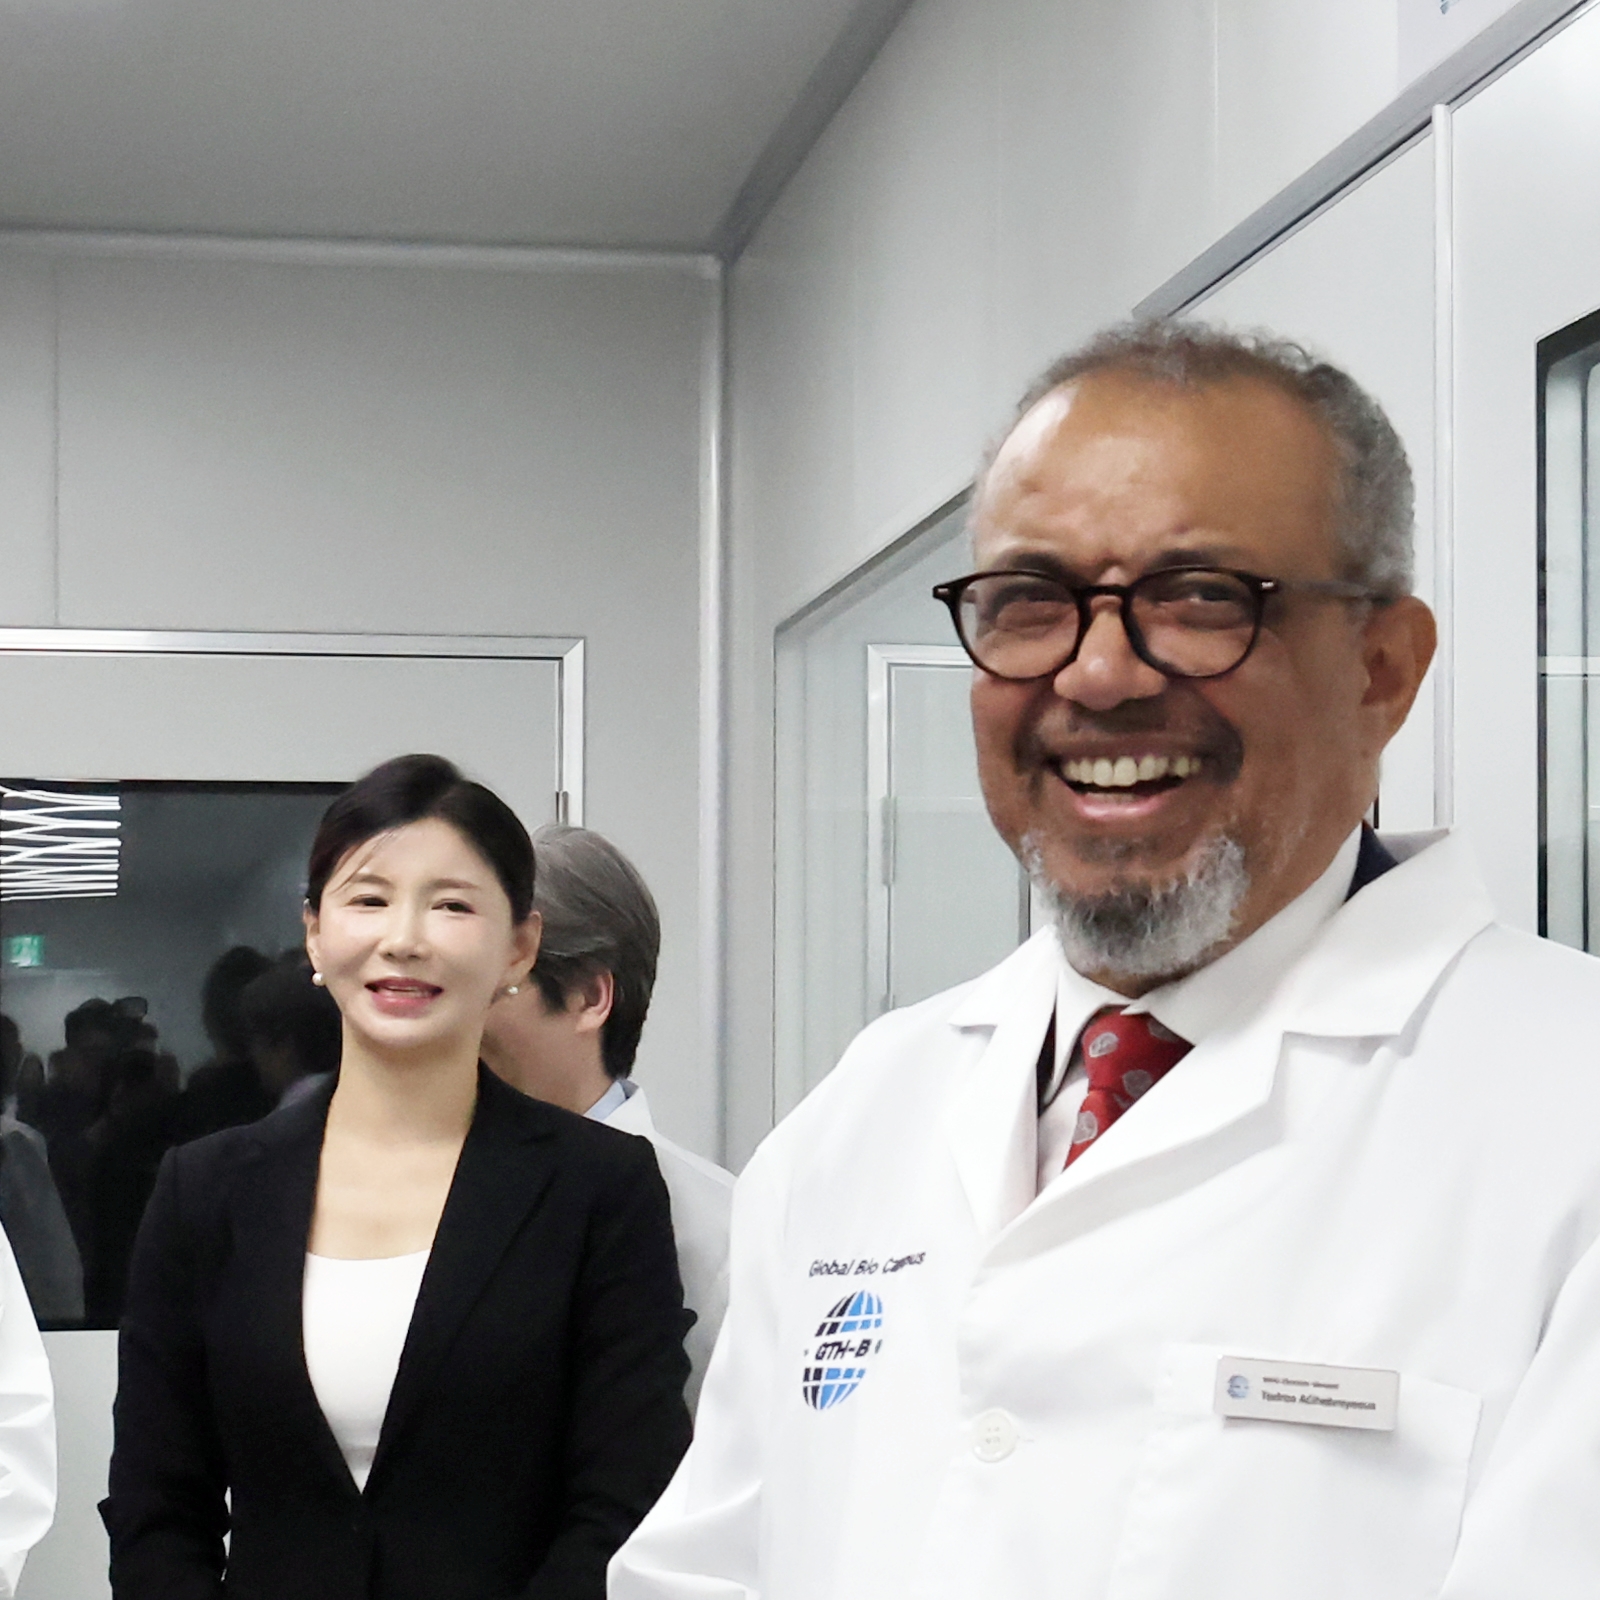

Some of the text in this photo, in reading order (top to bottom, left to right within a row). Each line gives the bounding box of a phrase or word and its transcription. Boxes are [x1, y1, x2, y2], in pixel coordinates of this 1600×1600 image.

[809, 1258, 856, 1278] Global
[854, 1257, 880, 1276] Bio
[815, 1338, 873, 1361] GTH-B
